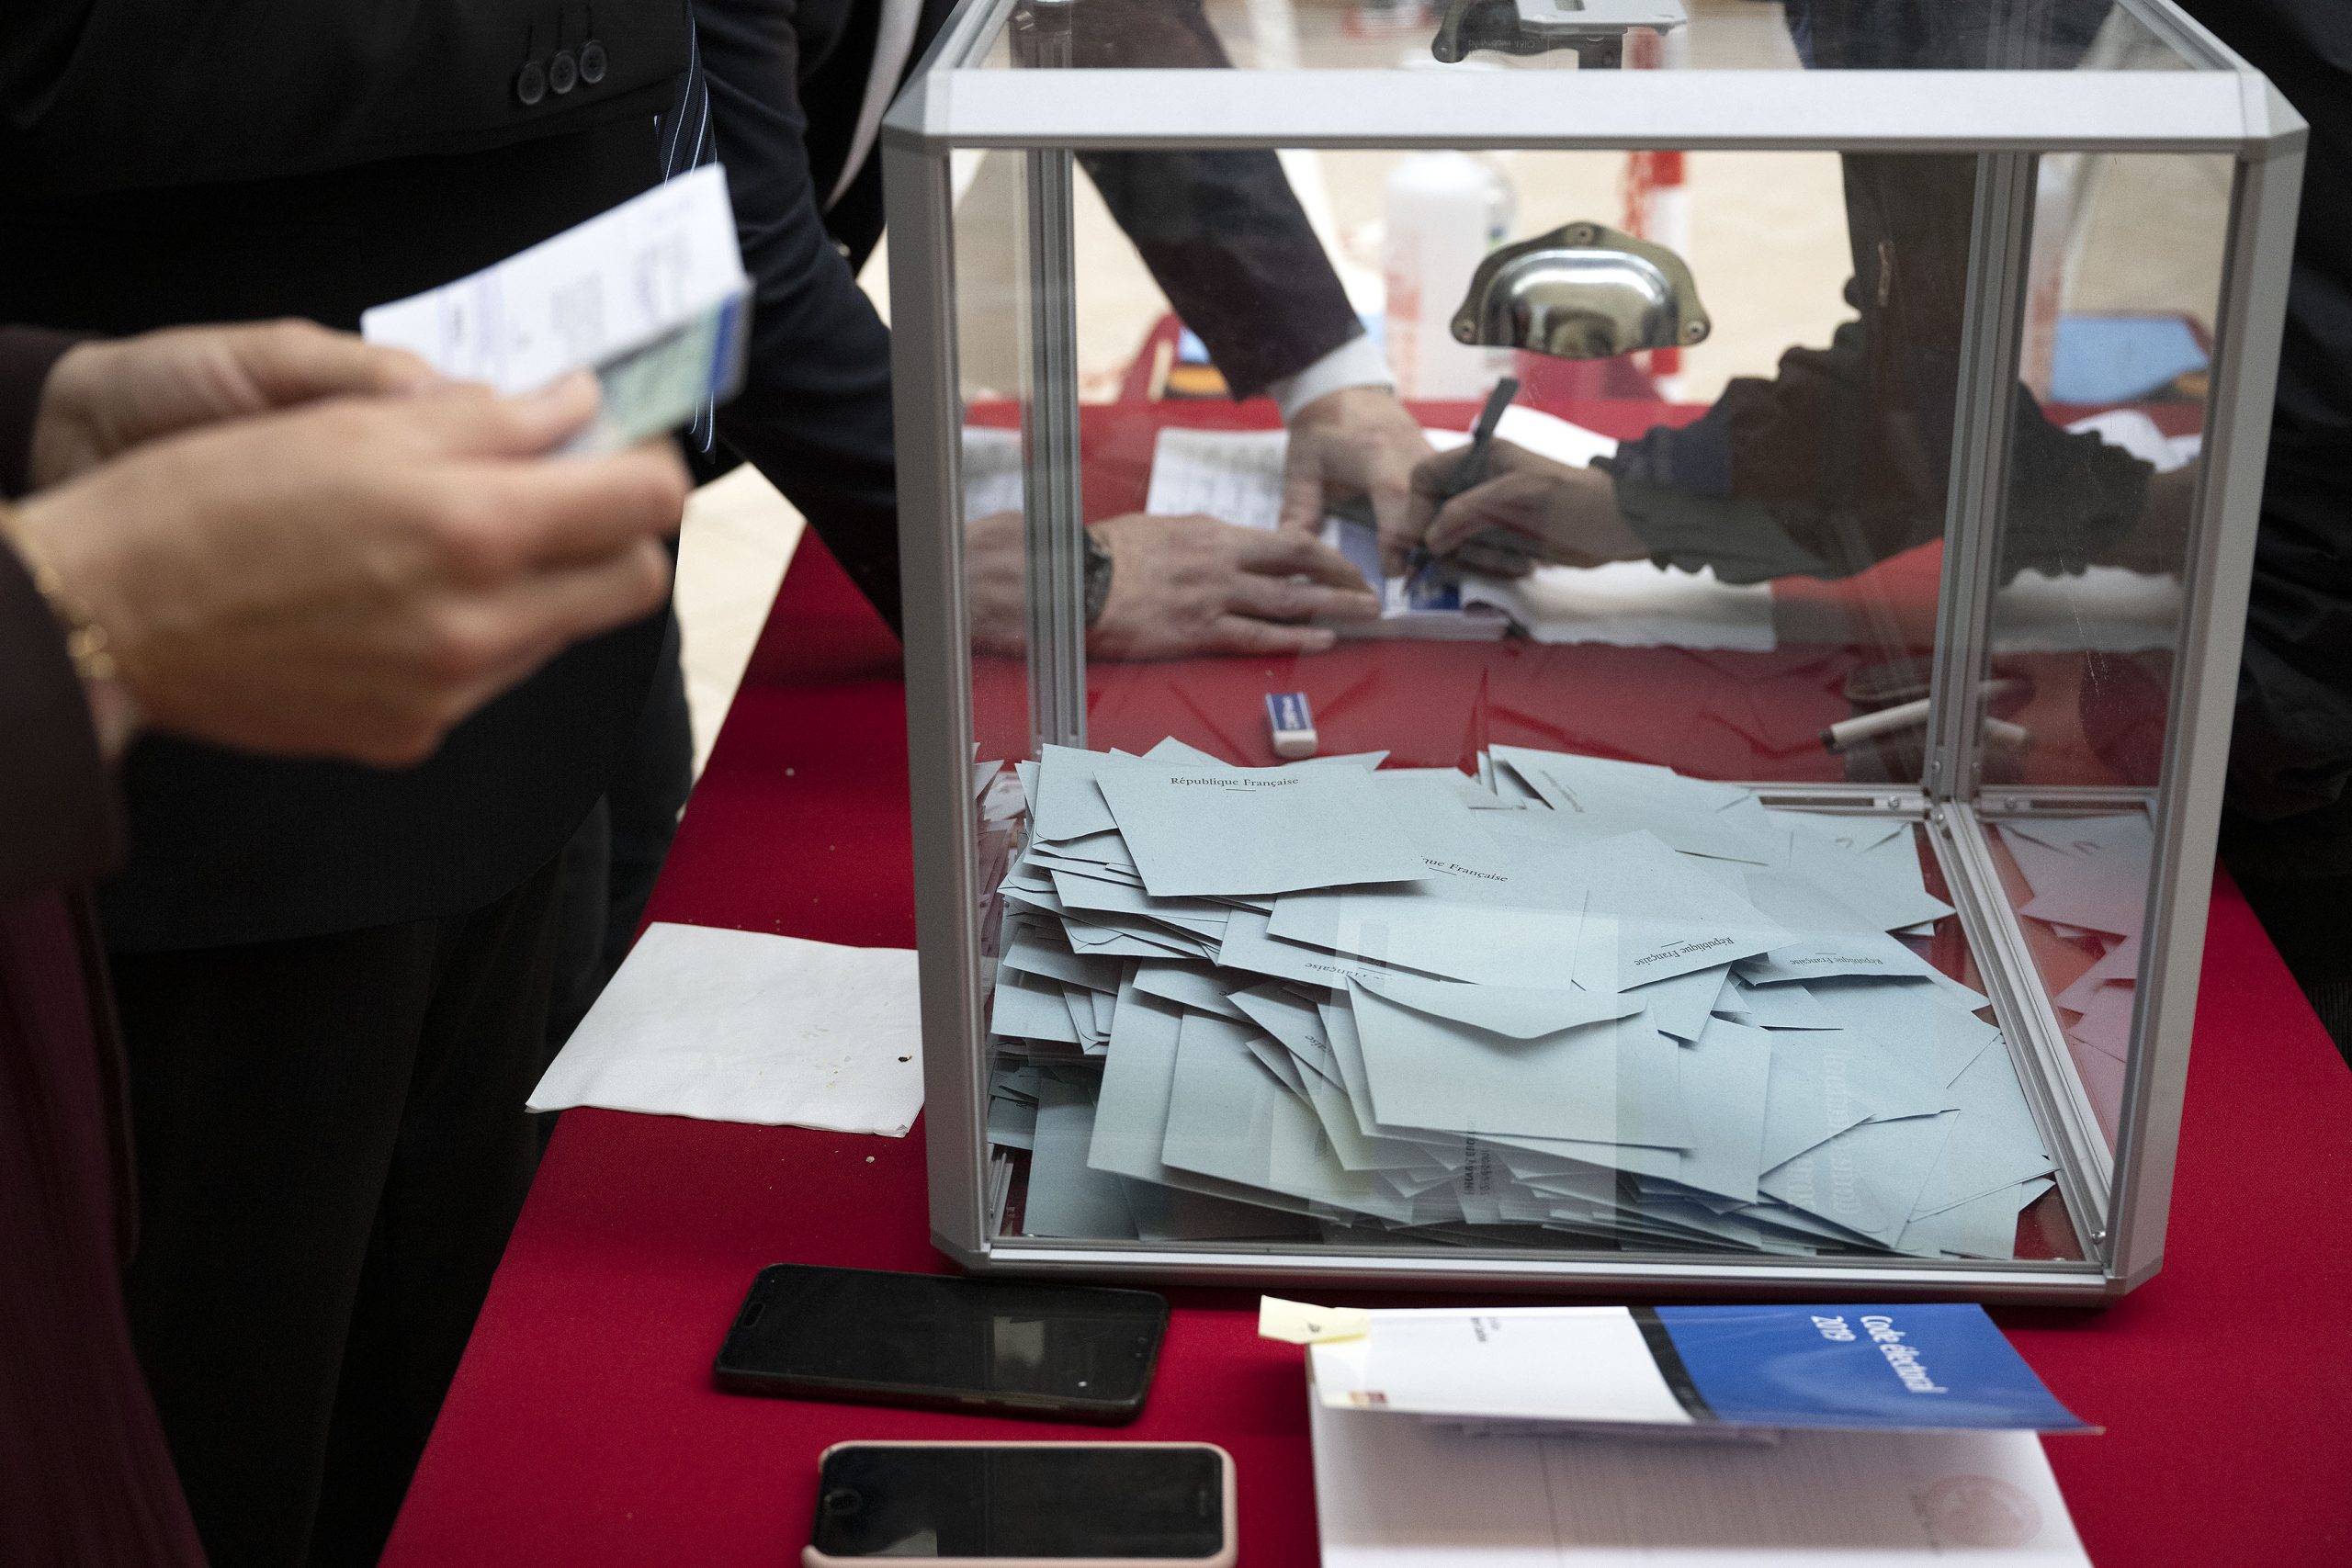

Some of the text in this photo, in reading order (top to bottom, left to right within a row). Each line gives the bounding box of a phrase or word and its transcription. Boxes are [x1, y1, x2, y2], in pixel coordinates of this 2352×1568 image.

[1170, 777, 1299, 787] République Française
[1449, 863, 1509, 882] Française
[1634, 937, 1735, 965] République Française
[1810, 1315, 1857, 1342] 2019
[1860, 1315, 1949, 1393] Code électoral
